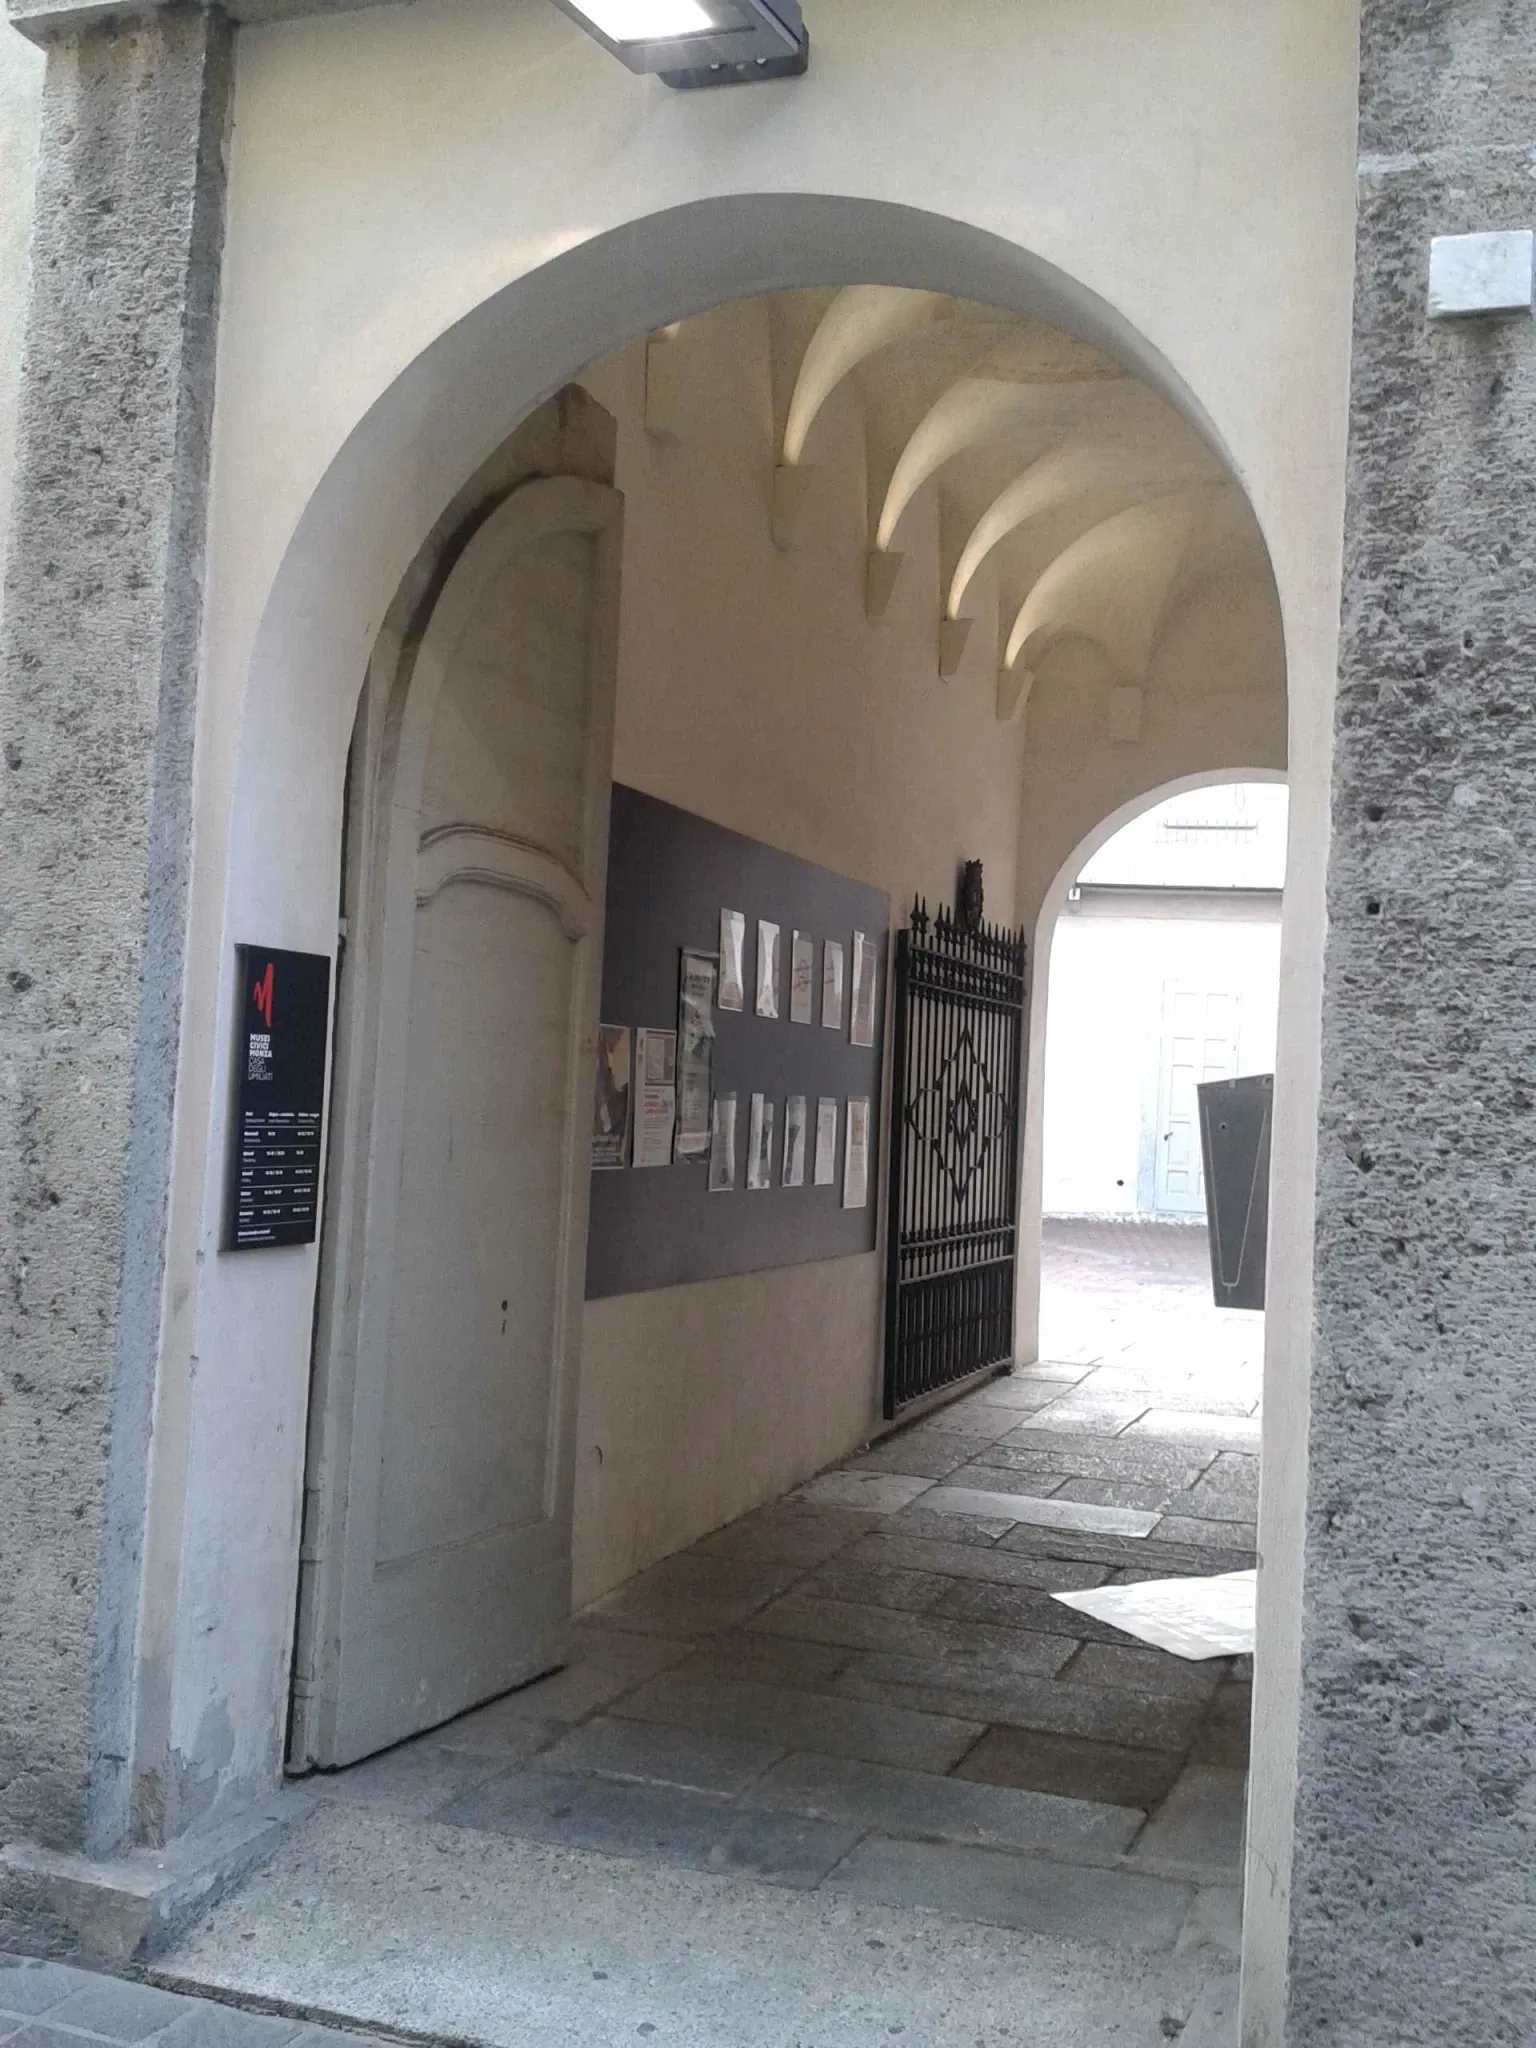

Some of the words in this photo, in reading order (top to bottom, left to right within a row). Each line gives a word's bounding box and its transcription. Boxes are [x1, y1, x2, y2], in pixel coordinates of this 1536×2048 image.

[250, 1034, 270, 1042] MUSEI
[250, 1042, 269, 1050] CIVICI
[249, 1049, 273, 1057] MONZA
[248, 1056, 265, 1064] CASA
